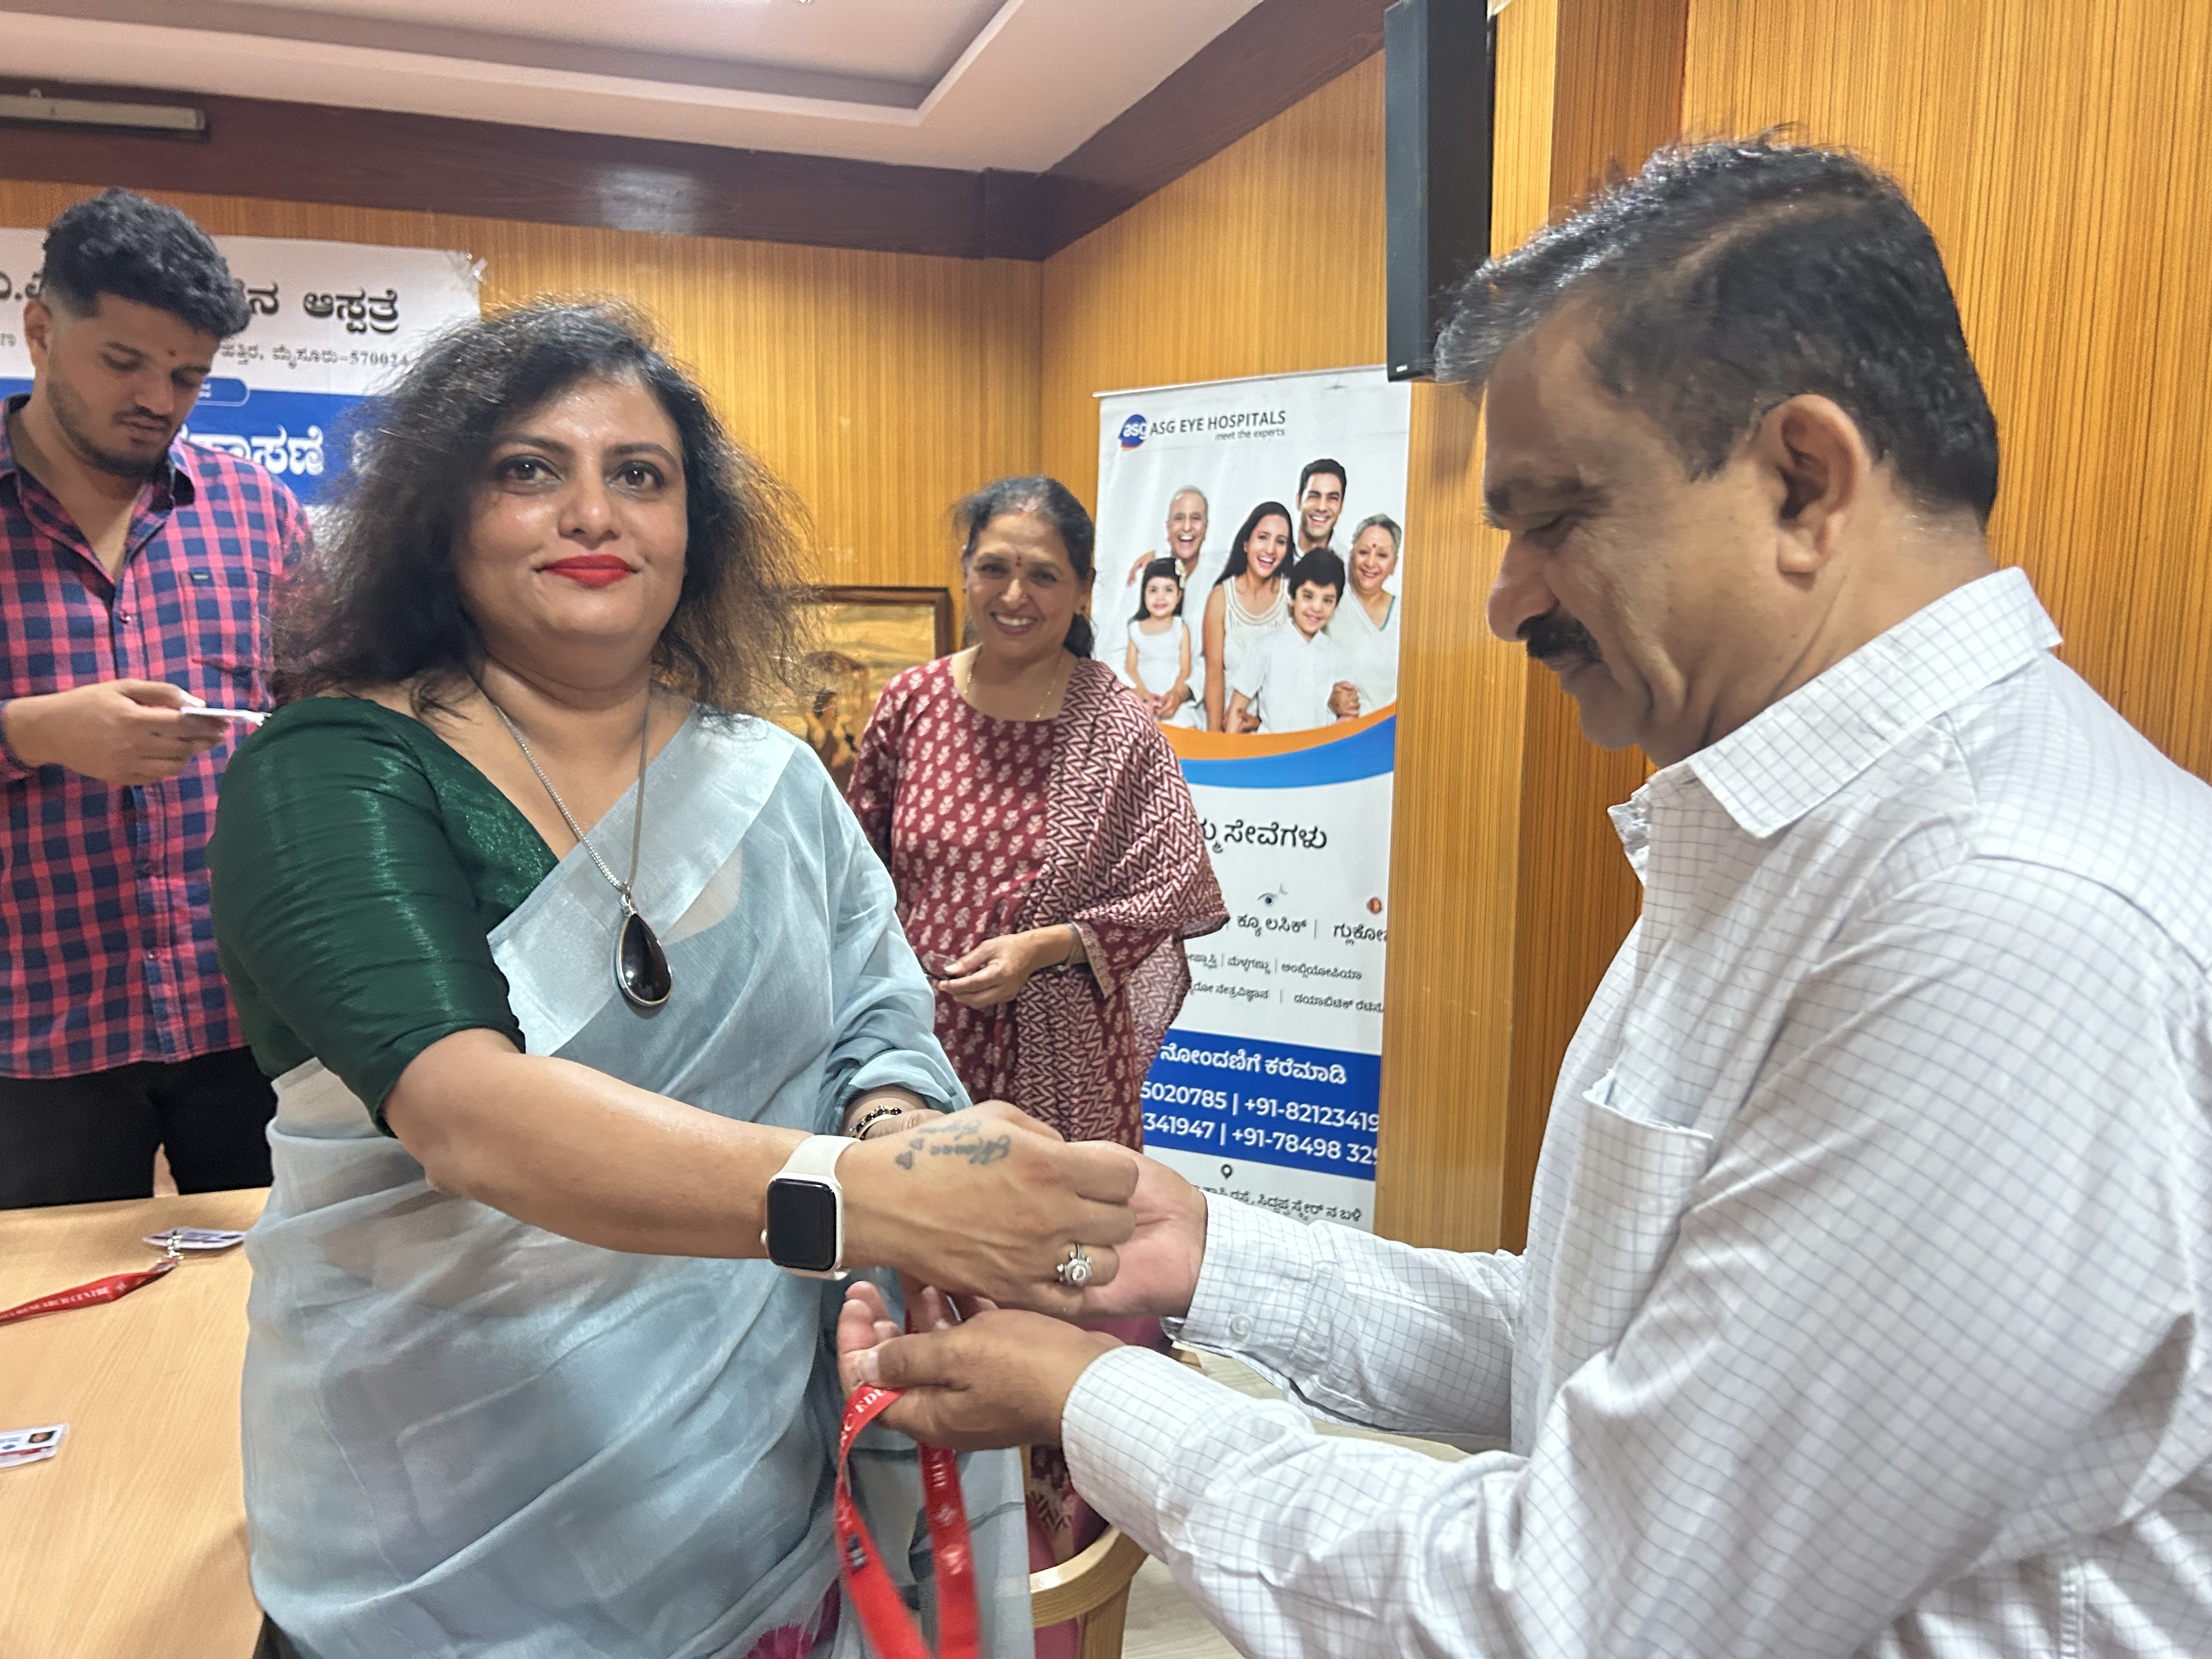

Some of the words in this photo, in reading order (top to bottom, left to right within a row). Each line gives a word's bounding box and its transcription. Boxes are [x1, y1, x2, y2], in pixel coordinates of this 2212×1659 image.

[303, 286, 400, 334] ಆಸ್ಪತ್ರೆ
[1149, 420, 1176, 436] ASG
[1180, 417, 1205, 433] EYE
[1207, 410, 1286, 431] HOSPITALS
[1215, 431, 1236, 441] meet
[1238, 430, 1251, 438] the
[1254, 427, 1285, 439] experts
[1224, 819, 1327, 849] ಸೇವೆಗಳು
[1159, 1042, 1262, 1073] ನೋಂದಣಿಗೆ
[1265, 1057, 1348, 1086] ಕರೆಮಾಡಿ
[1244, 1097, 1380, 1132] +91-82123419
[1232, 1126, 1342, 1159] +91-78498
